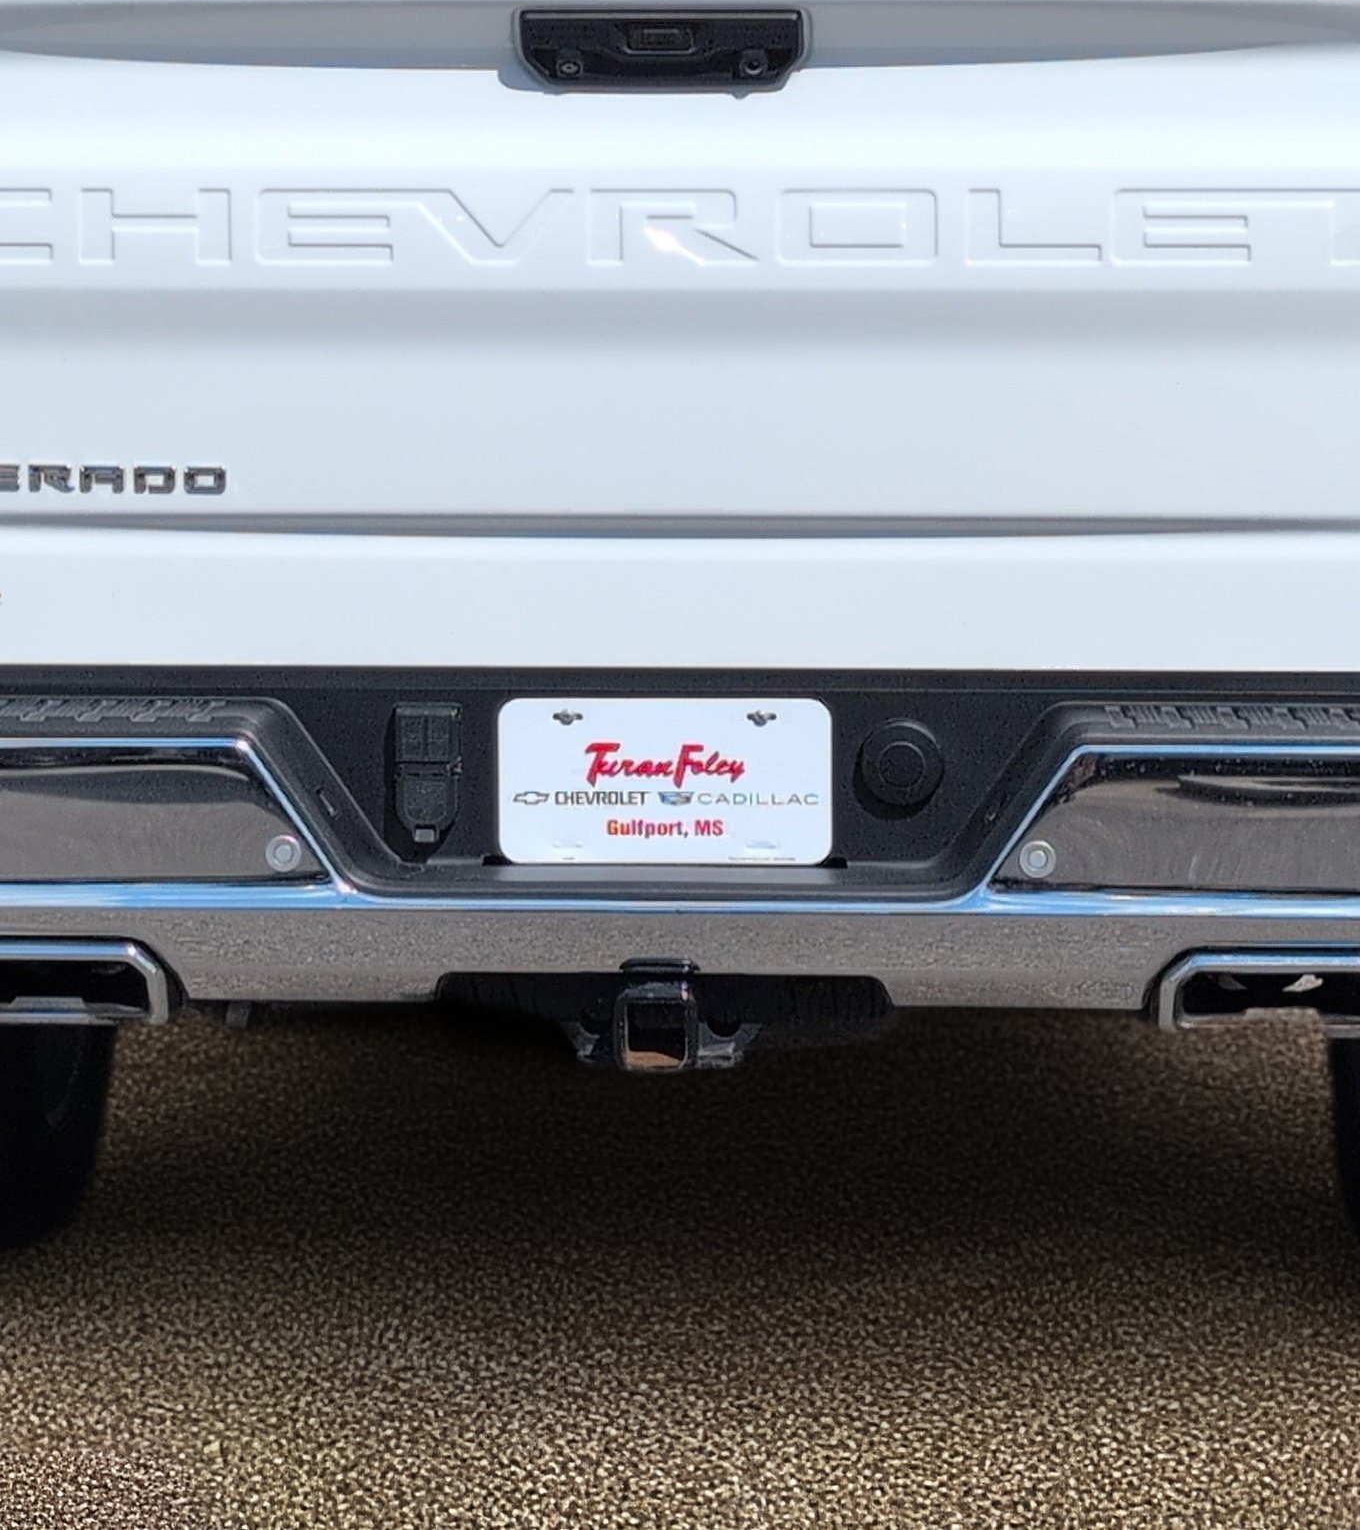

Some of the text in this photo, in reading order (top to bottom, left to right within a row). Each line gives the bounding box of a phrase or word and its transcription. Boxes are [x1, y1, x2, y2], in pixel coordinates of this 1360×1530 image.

[554, 790, 819, 806] CHEVROLET CADILLAC
[606, 819, 724, 839] Gulfport, MS
